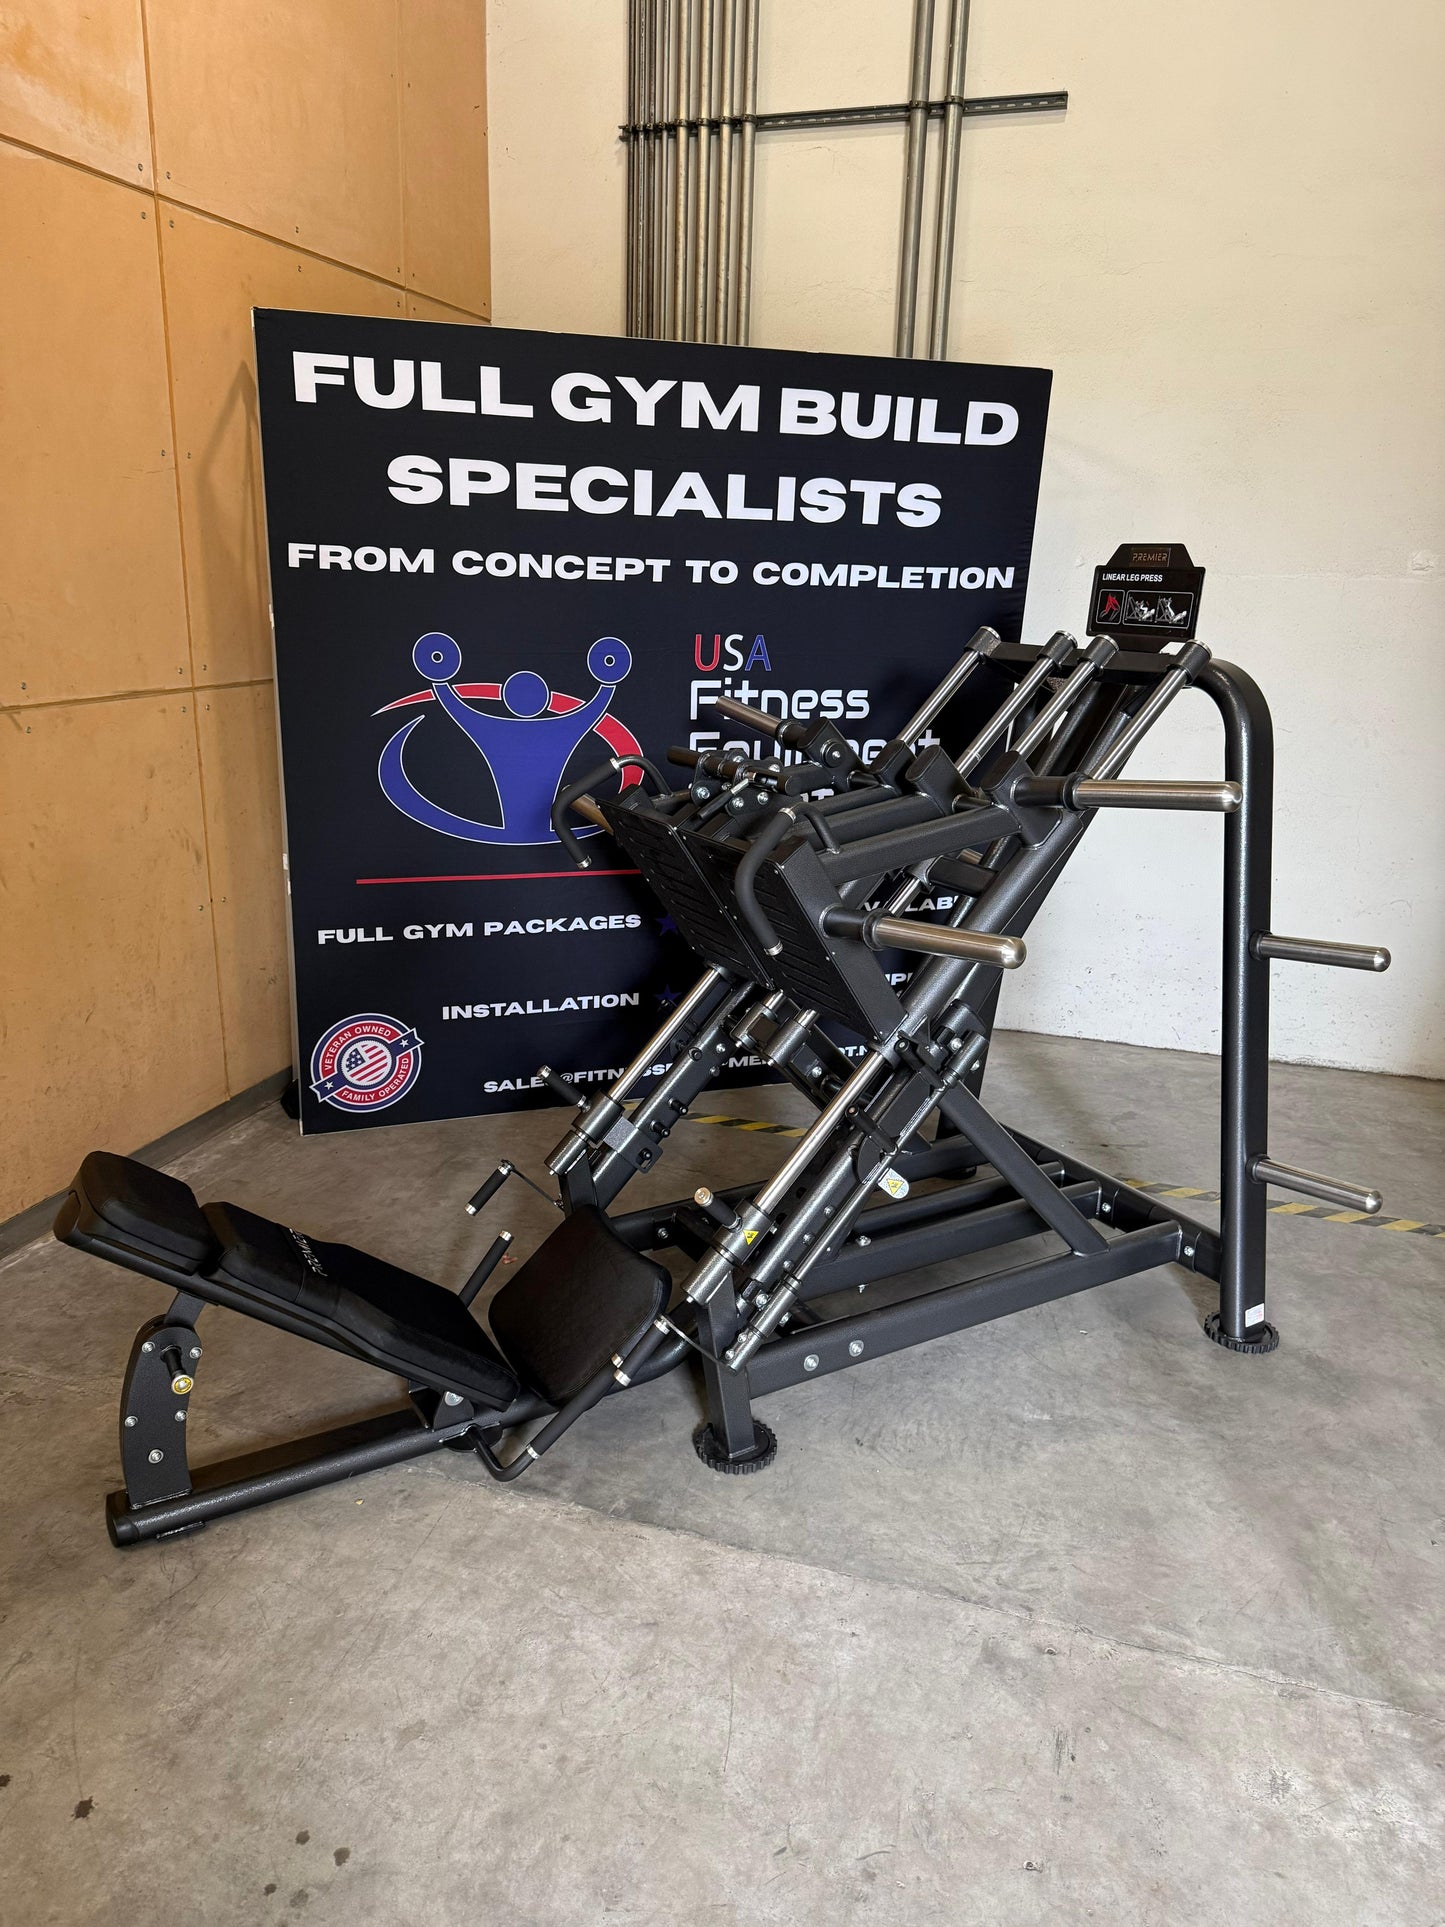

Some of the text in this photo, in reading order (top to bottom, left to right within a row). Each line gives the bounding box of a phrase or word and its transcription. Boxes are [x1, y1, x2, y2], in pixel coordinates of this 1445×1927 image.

[292, 350, 1019, 446] FULL GYM BUILD
[387, 454, 943, 528] SPECIALISTS
[288, 542, 1015, 590] FROM CONCEPT TO COMPLETION
[1102, 573, 1163, 583] LINEAR LEG PRESS
[1132, 552, 1168, 562] PREMIER
[694, 633, 772, 672] USA
[317, 914, 642, 945] FULL GYM PACKAGES
[442, 992, 639, 1020] INSTALLATION
[324, 1025, 391, 1071] VETERAN OWNED
[341, 1057, 409, 1102] FAMILY OPERATED
